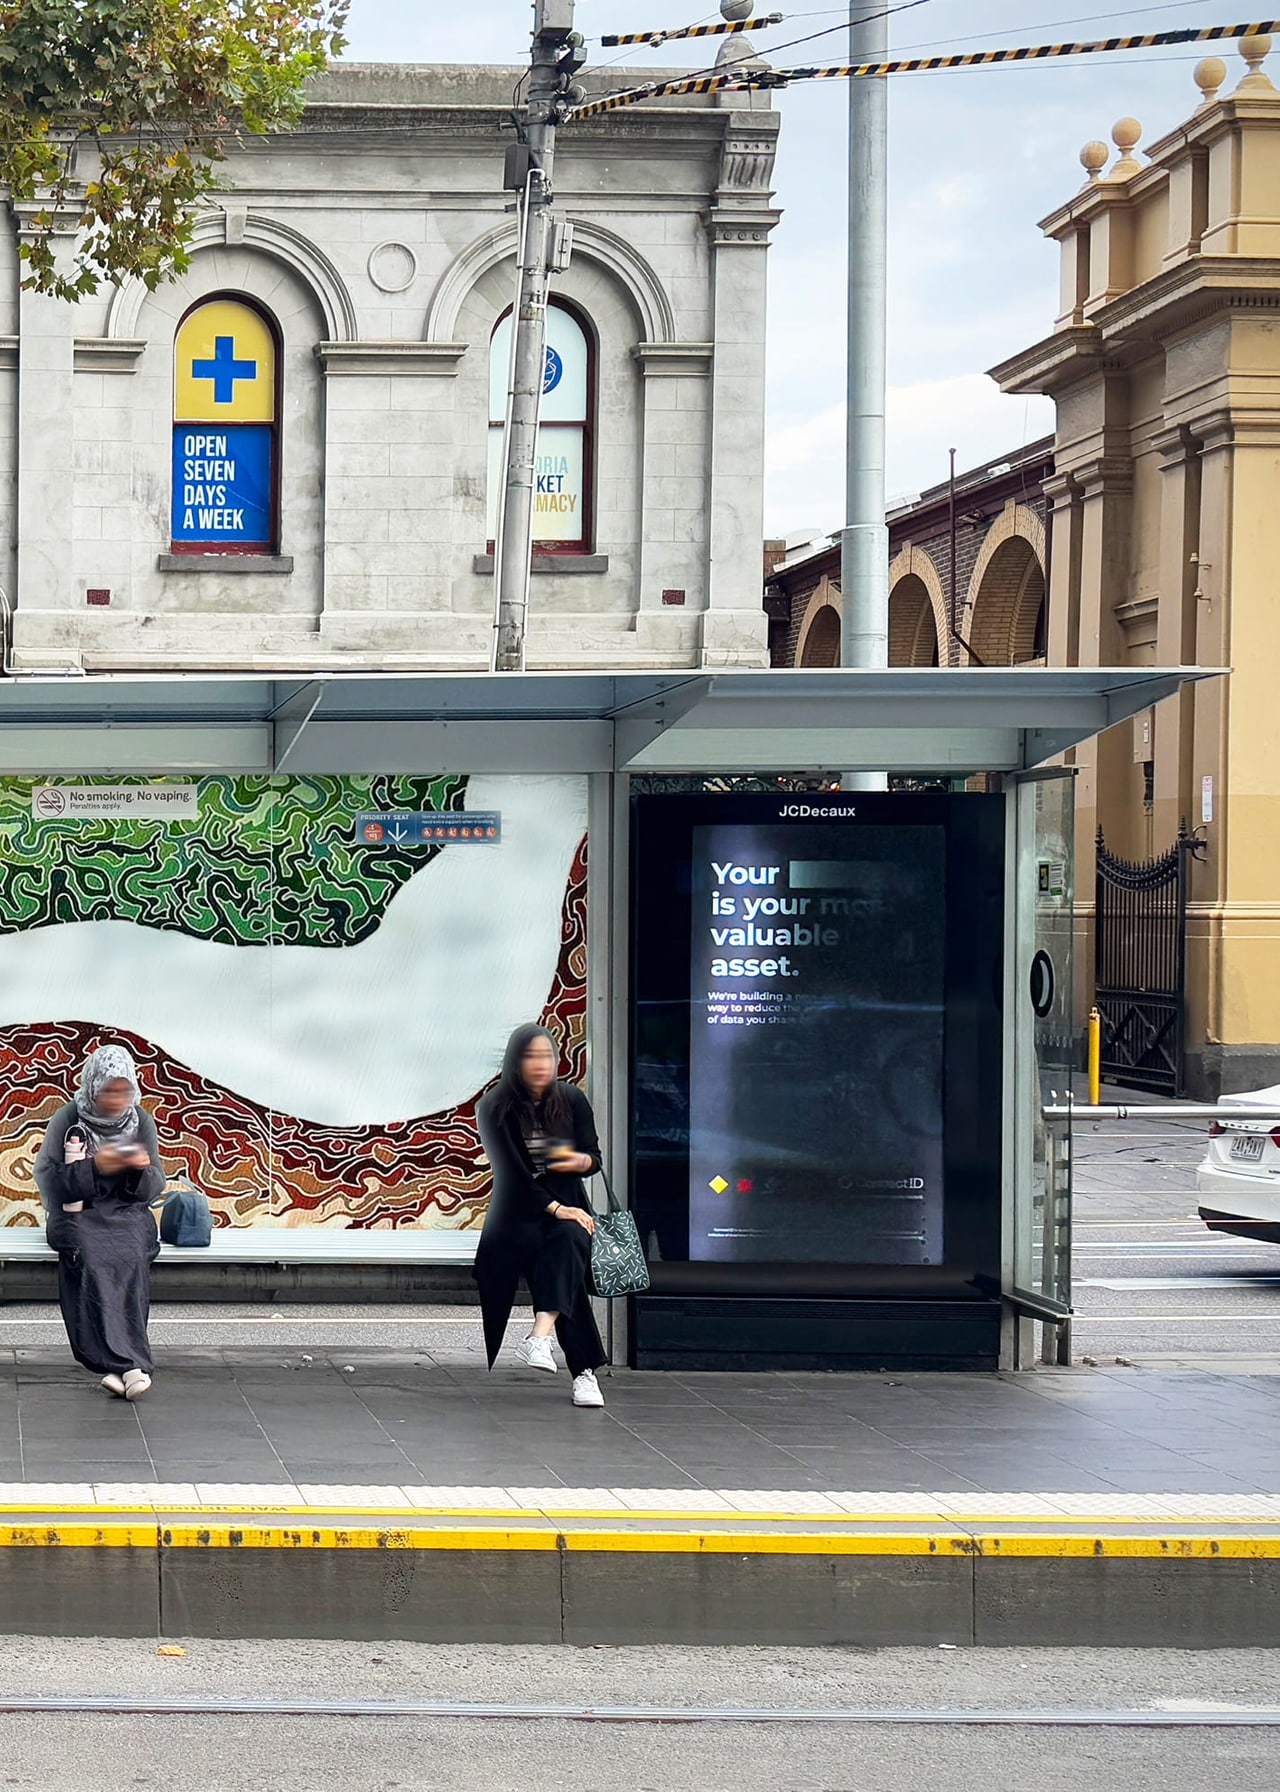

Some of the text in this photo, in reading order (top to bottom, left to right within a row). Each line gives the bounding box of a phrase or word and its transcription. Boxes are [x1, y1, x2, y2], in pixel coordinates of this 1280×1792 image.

[184, 435, 227, 457] OPEN
[184, 459, 235, 481] SEVEN
[536, 456, 568, 474] ORIA
[536, 474, 564, 493] KET
[184, 484, 226, 506] DAYS
[536, 494, 577, 513] MACY
[183, 508, 244, 530] A WEEK
[70, 790, 192, 803] No smoking. No vaping.
[779, 805, 856, 817] JCDecaux
[710, 862, 780, 885] Your
[712, 891, 736, 916] is
[742, 897, 811, 921] your
[710, 923, 840, 946] valuable
[710, 956, 800, 977] asset.
[707, 992, 738, 1001] We're
[739, 991, 784, 1002] building
[707, 1004, 729, 1014] way
[730, 1003, 743, 1012] to
[744, 1003, 781, 1012] reduce
[707, 1015, 719, 1024] of
[720, 1015, 744, 1024] data
[745, 1016, 766, 1026] you
